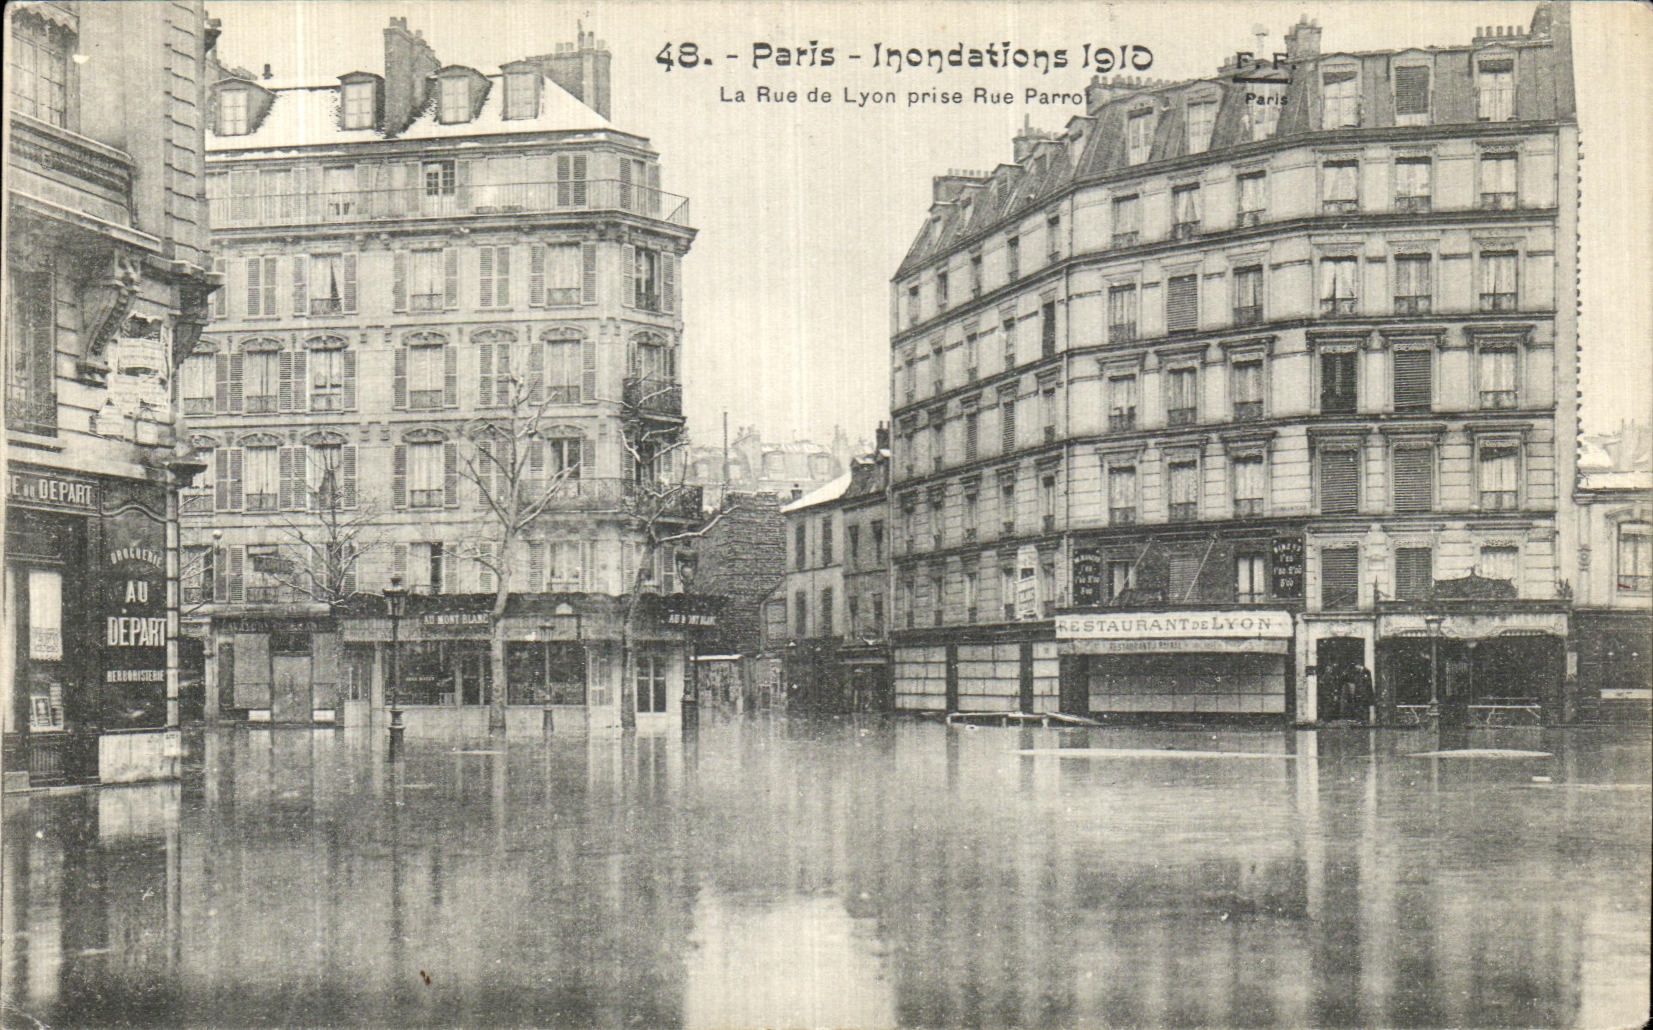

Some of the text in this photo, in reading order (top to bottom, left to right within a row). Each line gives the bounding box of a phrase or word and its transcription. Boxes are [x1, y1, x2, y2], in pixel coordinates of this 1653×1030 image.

[125, 580, 148, 603] AU
[1058, 618, 1190, 633] RESTAURANT
[1211, 616, 1271, 631] LYON
